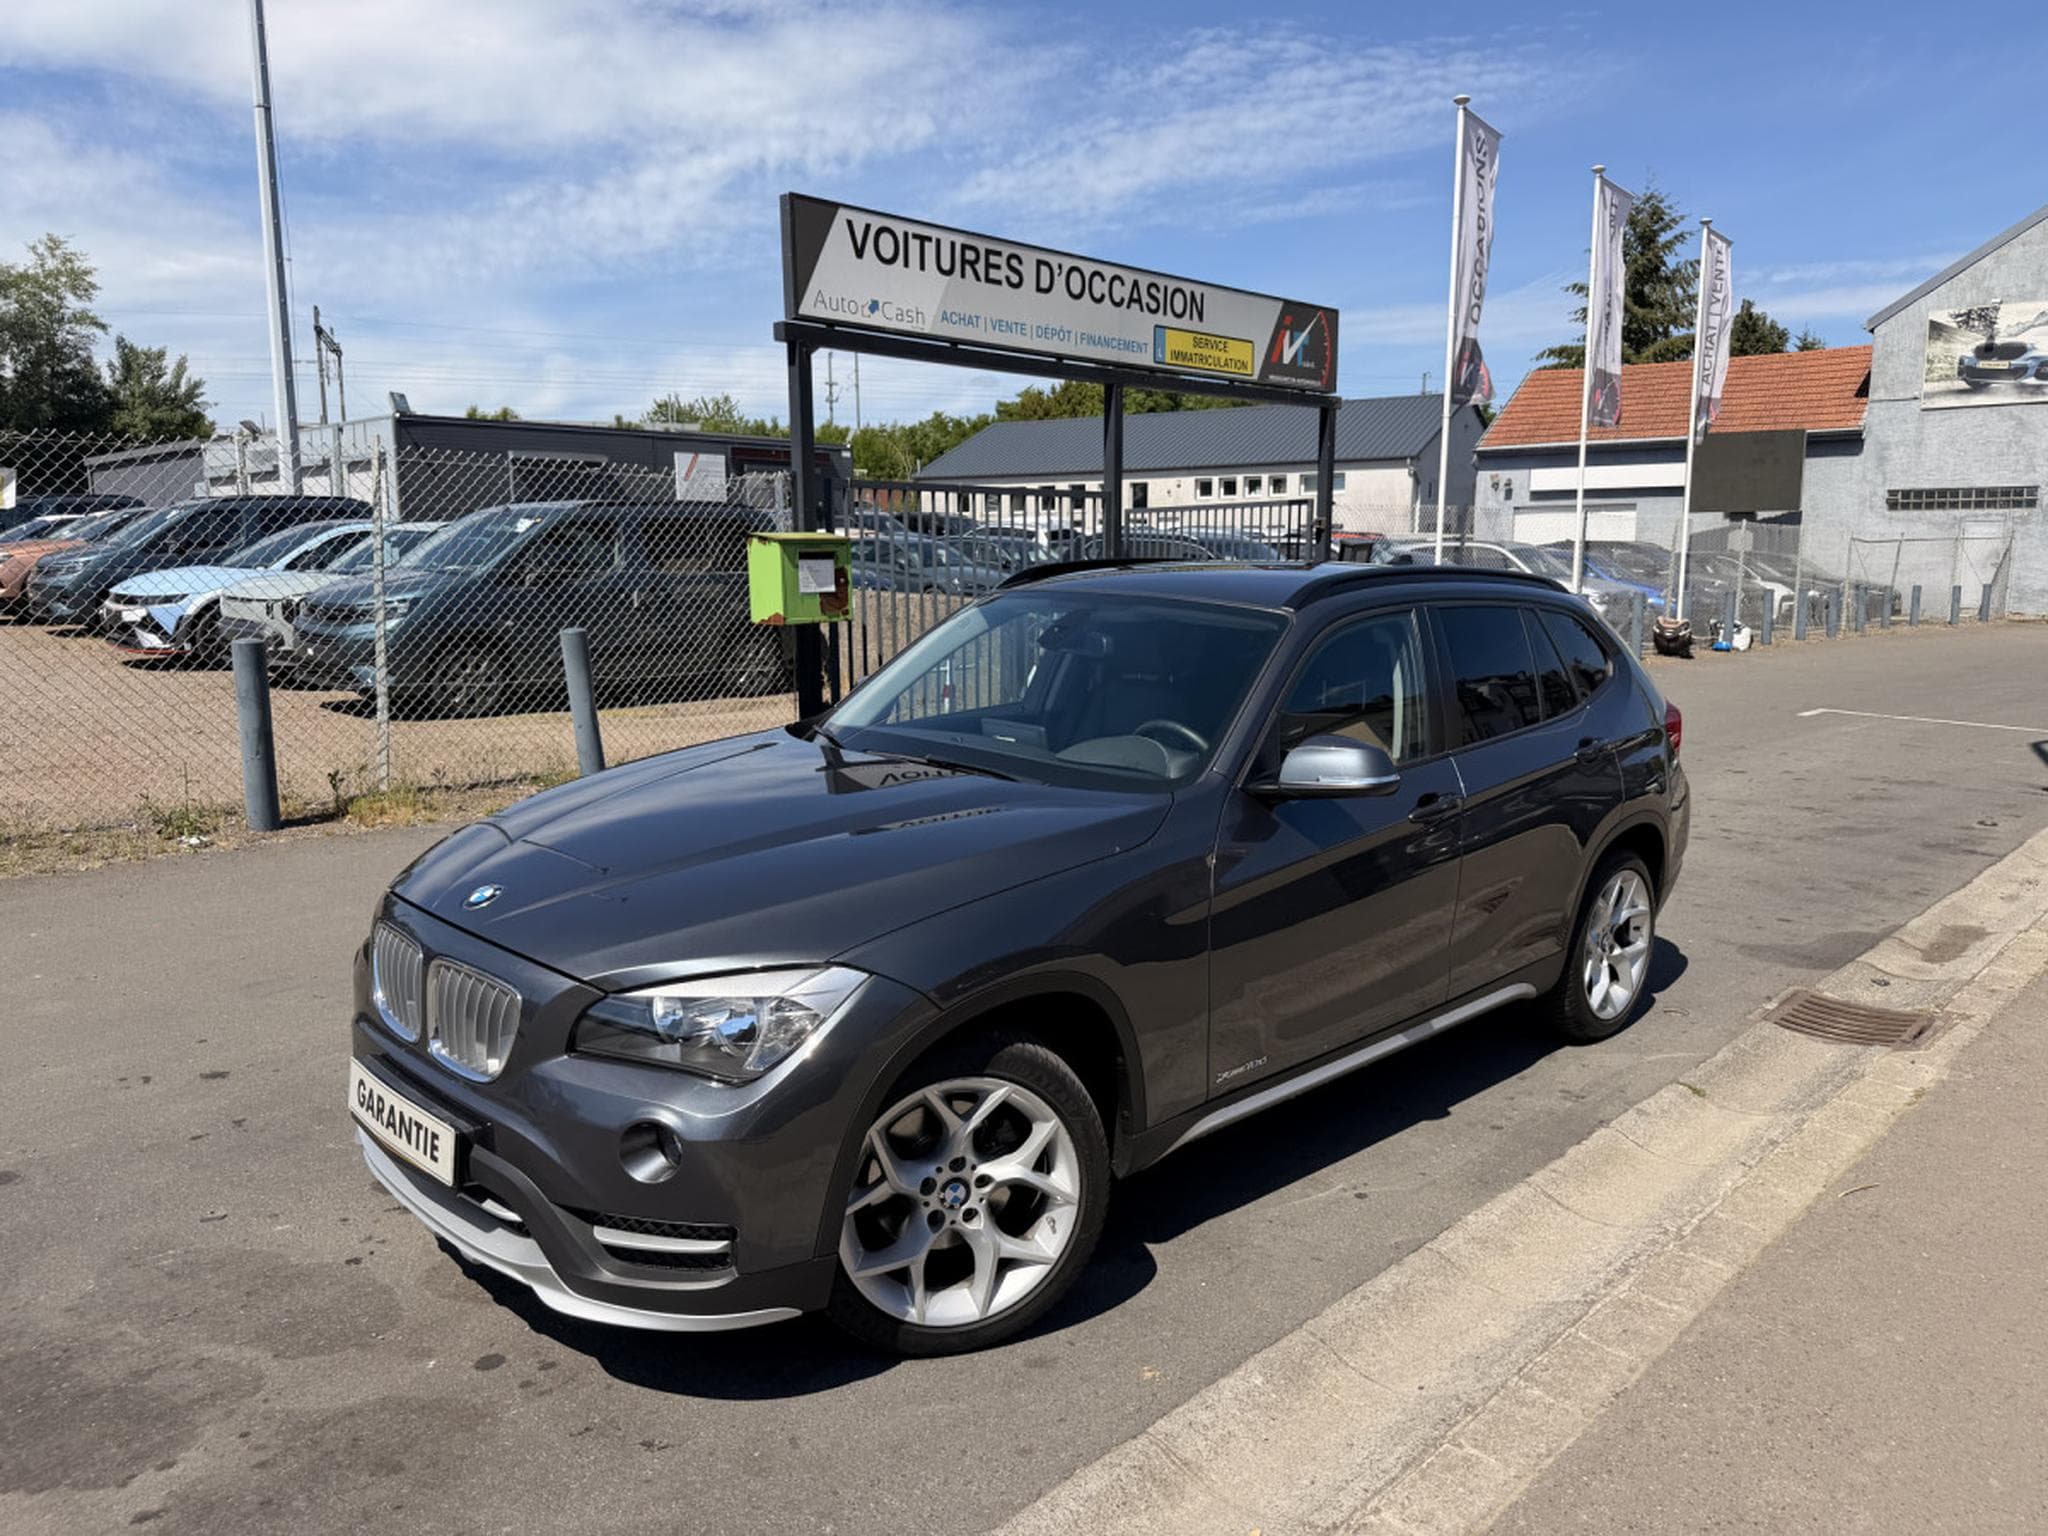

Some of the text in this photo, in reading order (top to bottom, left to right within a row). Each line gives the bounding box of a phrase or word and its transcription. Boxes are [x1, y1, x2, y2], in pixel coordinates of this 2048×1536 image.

[846, 218, 1204, 322] VOITURES D'OCCASION
[813, 289, 926, 325] Auto Cash
[940, 310, 1149, 354] ACHAT VENTE DÉPÔT FINANCEMENT
[1192, 335, 1230, 353] SERVICE
[1170, 349, 1248, 371] IMMATRICULATION
[357, 1078, 439, 1163] GARANTIE
